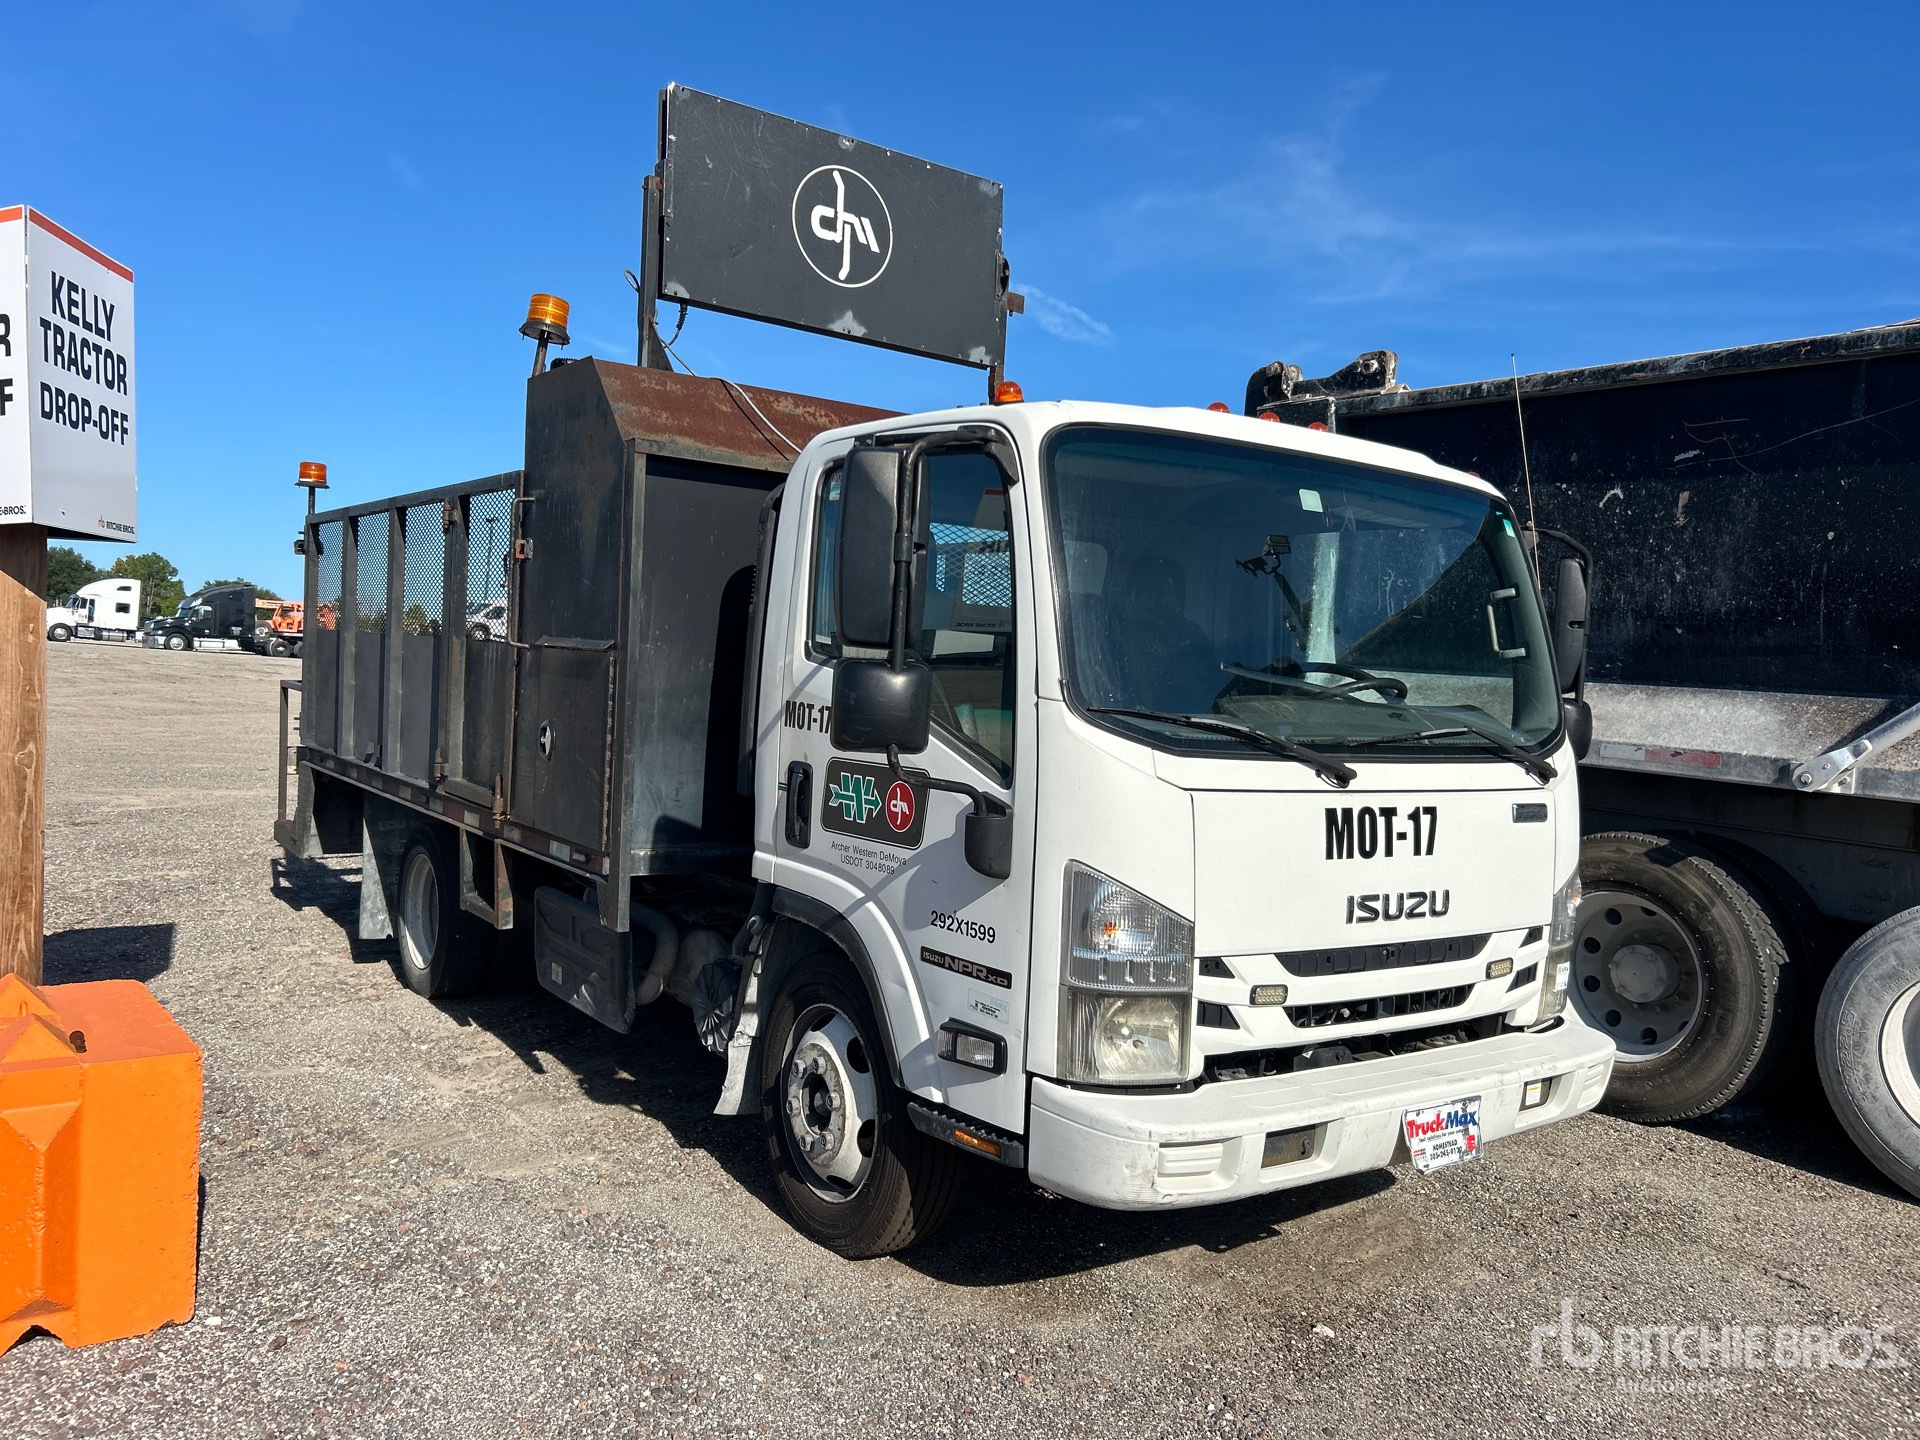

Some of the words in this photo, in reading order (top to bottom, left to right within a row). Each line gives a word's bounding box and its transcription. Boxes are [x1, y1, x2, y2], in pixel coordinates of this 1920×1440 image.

[51, 270, 115, 342] KELLY
[39, 316, 128, 396] TRACTOR
[40, 381, 129, 446] DROP-OFF
[1324, 806, 1438, 861] MOT-17
[831, 840, 851, 853] Archer
[852, 844, 878, 859] Western
[879, 850, 907, 867] DeMoya
[840, 854, 863, 868] USDOT
[865, 859, 895, 875] 3048089
[1345, 889, 1450, 925] ISUZU
[930, 910, 996, 944] 292X1599
[923, 951, 944, 964] ISUZU
[944, 955, 987, 980] NPR
[1406, 1110, 1478, 1139] TruckMax
[1432, 1139, 1458, 1152] HOMESTEAD
